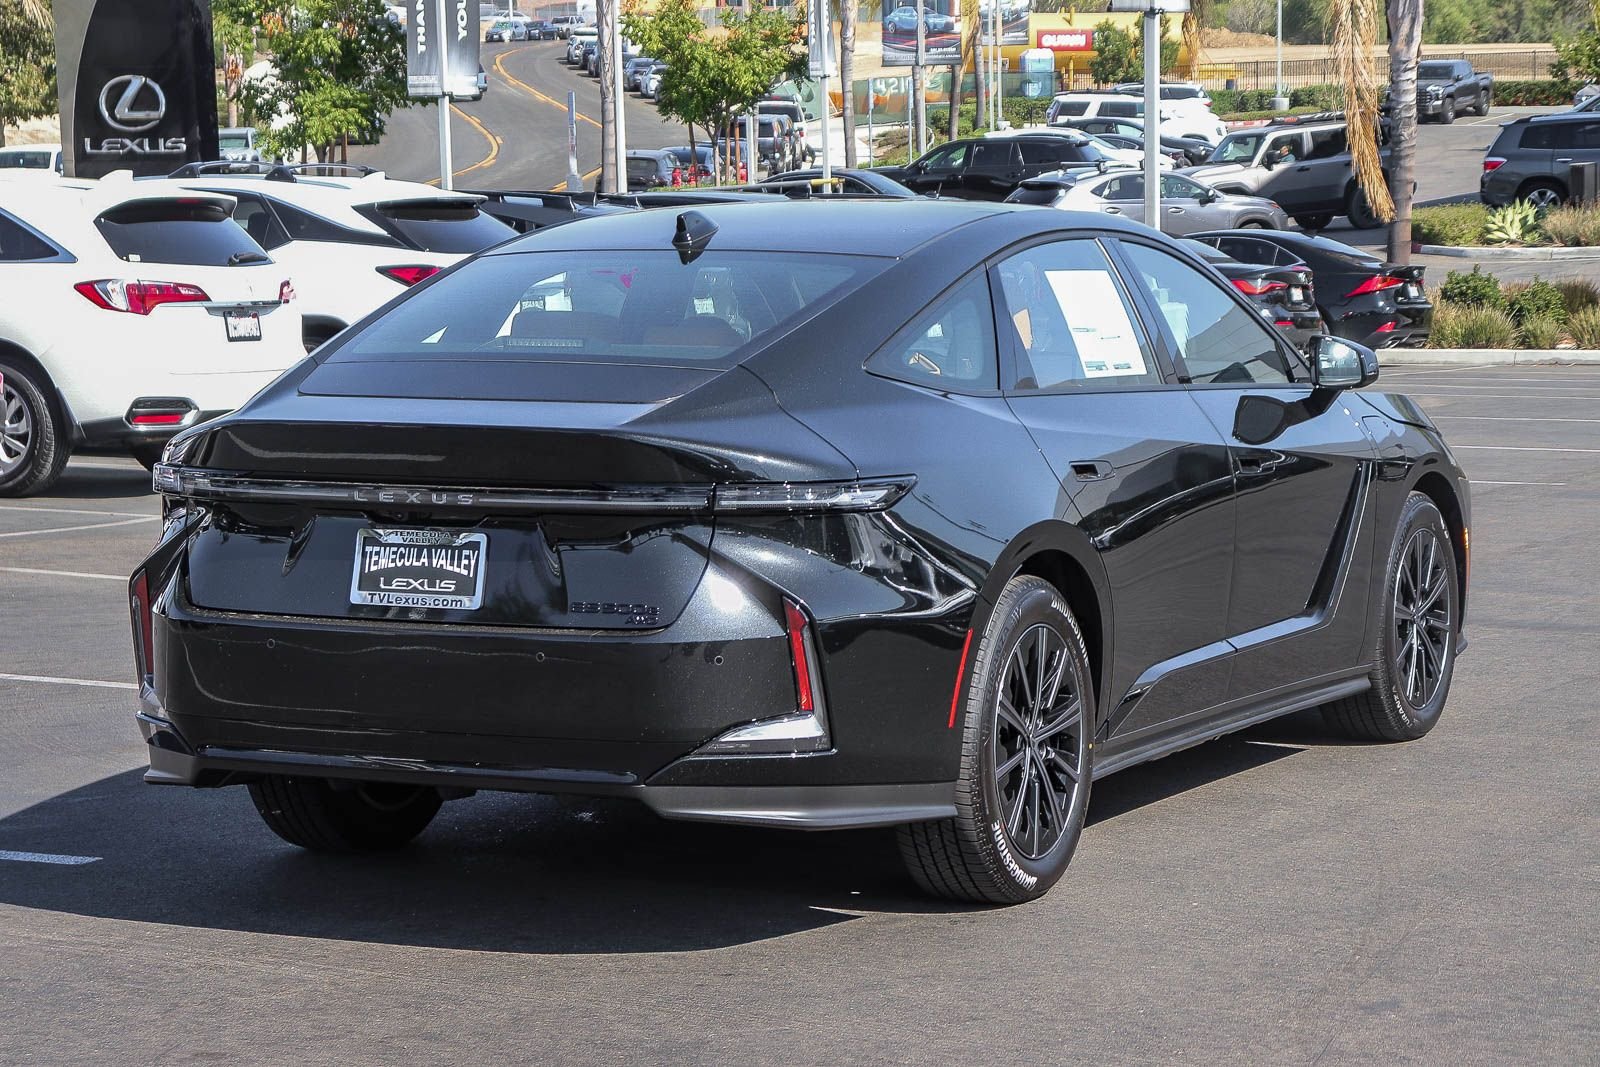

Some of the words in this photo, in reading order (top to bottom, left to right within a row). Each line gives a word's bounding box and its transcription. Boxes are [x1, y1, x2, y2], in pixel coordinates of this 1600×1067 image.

[84, 137, 187, 154] LEXUS
[353, 490, 474, 505] LEXUS
[394, 530, 452, 539] TEMECULA
[364, 546, 429, 574] TEMECULA
[432, 549, 479, 578] VALLEY
[379, 577, 457, 592] LEXUS
[367, 592, 463, 608] TVLexus.com
[991, 819, 1038, 892] BRIDGESTONE
